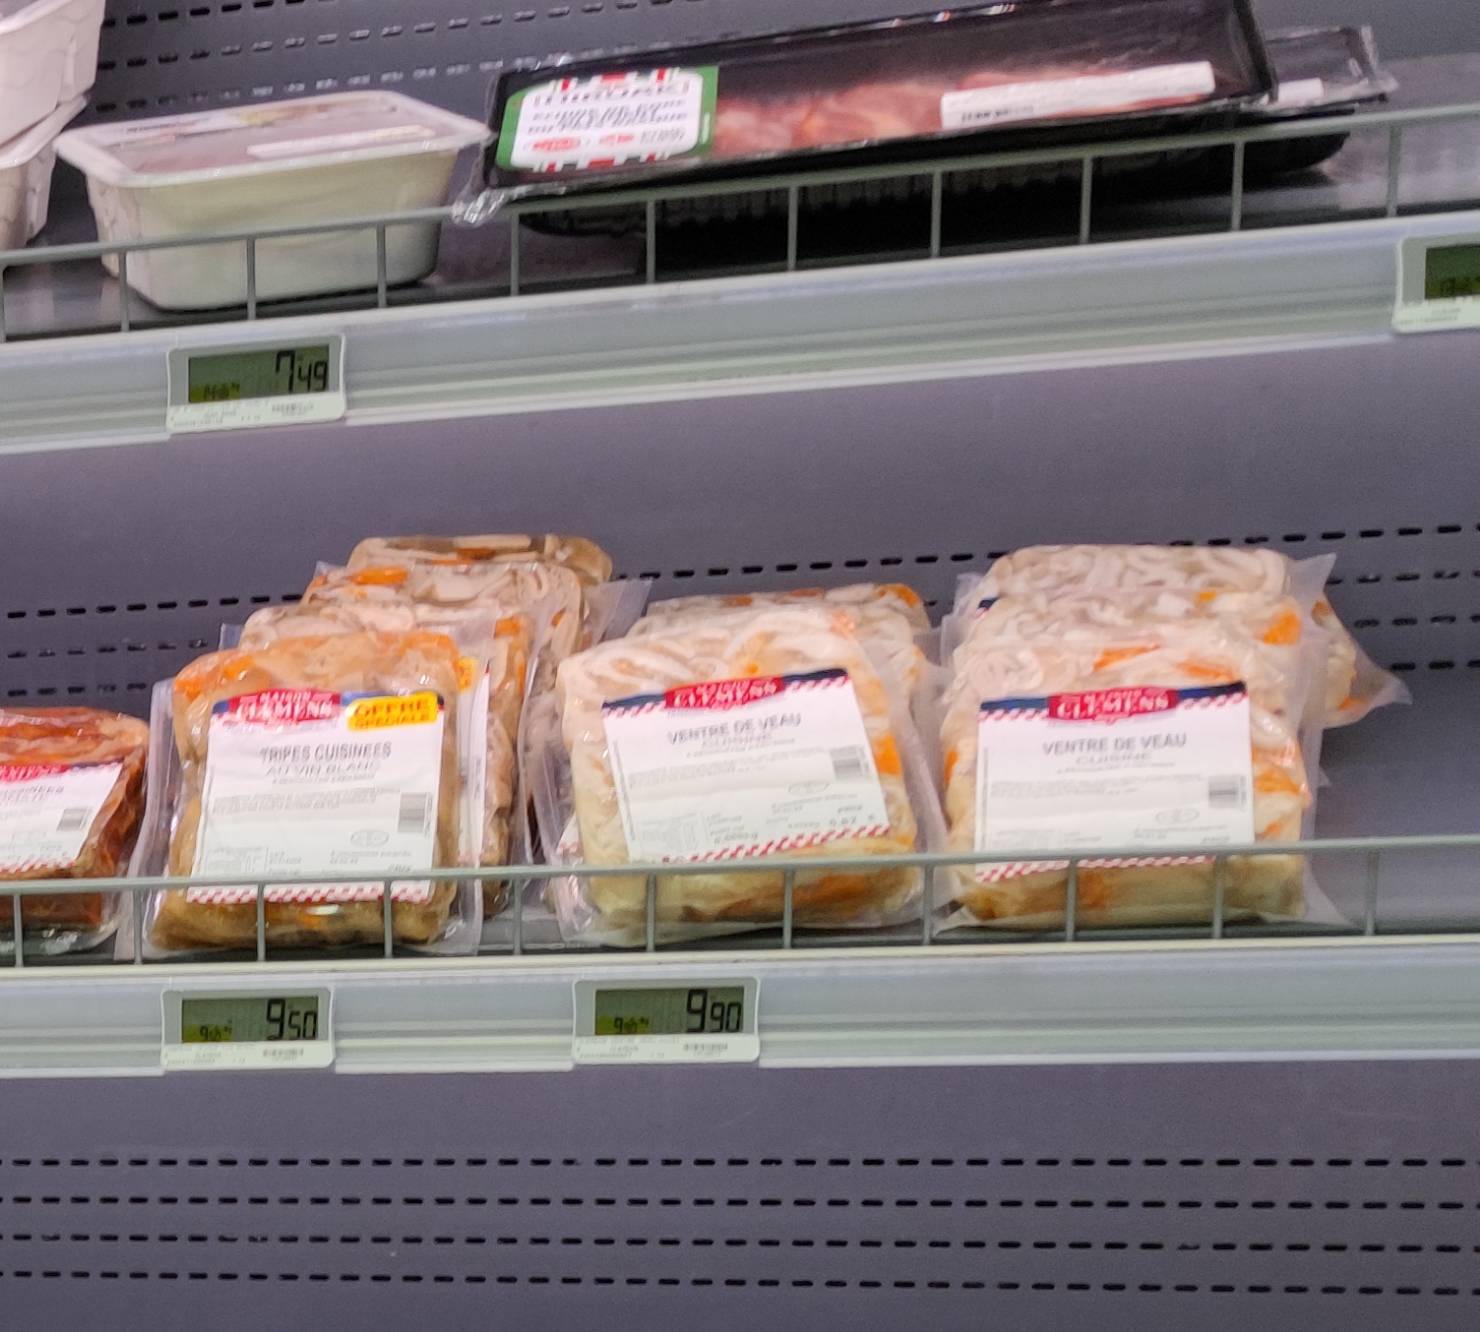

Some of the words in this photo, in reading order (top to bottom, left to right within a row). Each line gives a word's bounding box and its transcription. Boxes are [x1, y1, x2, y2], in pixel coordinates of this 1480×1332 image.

[354, 698, 431, 716] OFFRE
[669, 721, 731, 745] VENTRE
[733, 719, 757, 735] DE
[760, 713, 802, 731] VEAU
[260, 745, 311, 764] TRIPES
[1043, 736, 1109, 756] VENTRE
[1114, 735, 1137, 751] DE
[1140, 732, 1187, 749] VEAU
